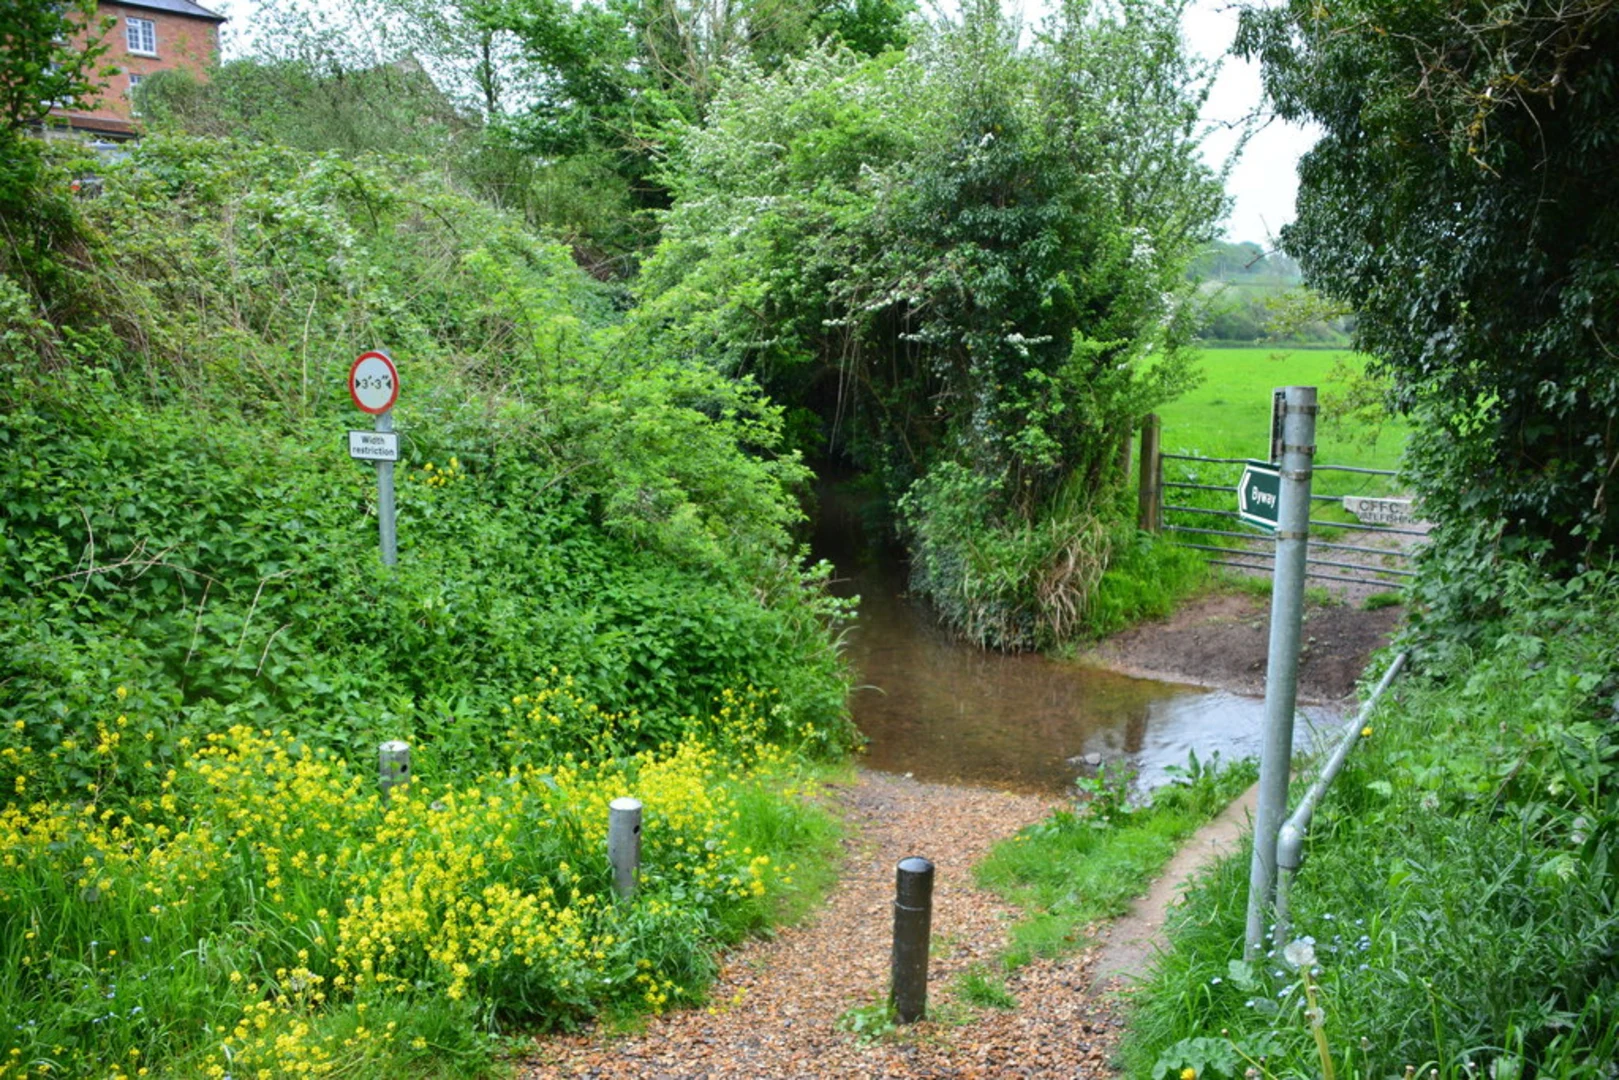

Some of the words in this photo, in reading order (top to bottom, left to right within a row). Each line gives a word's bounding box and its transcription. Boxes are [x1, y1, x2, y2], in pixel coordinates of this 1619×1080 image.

[360, 435, 385, 445] Width
[352, 446, 395, 456] restriction
[1251, 485, 1277, 509] Byway
